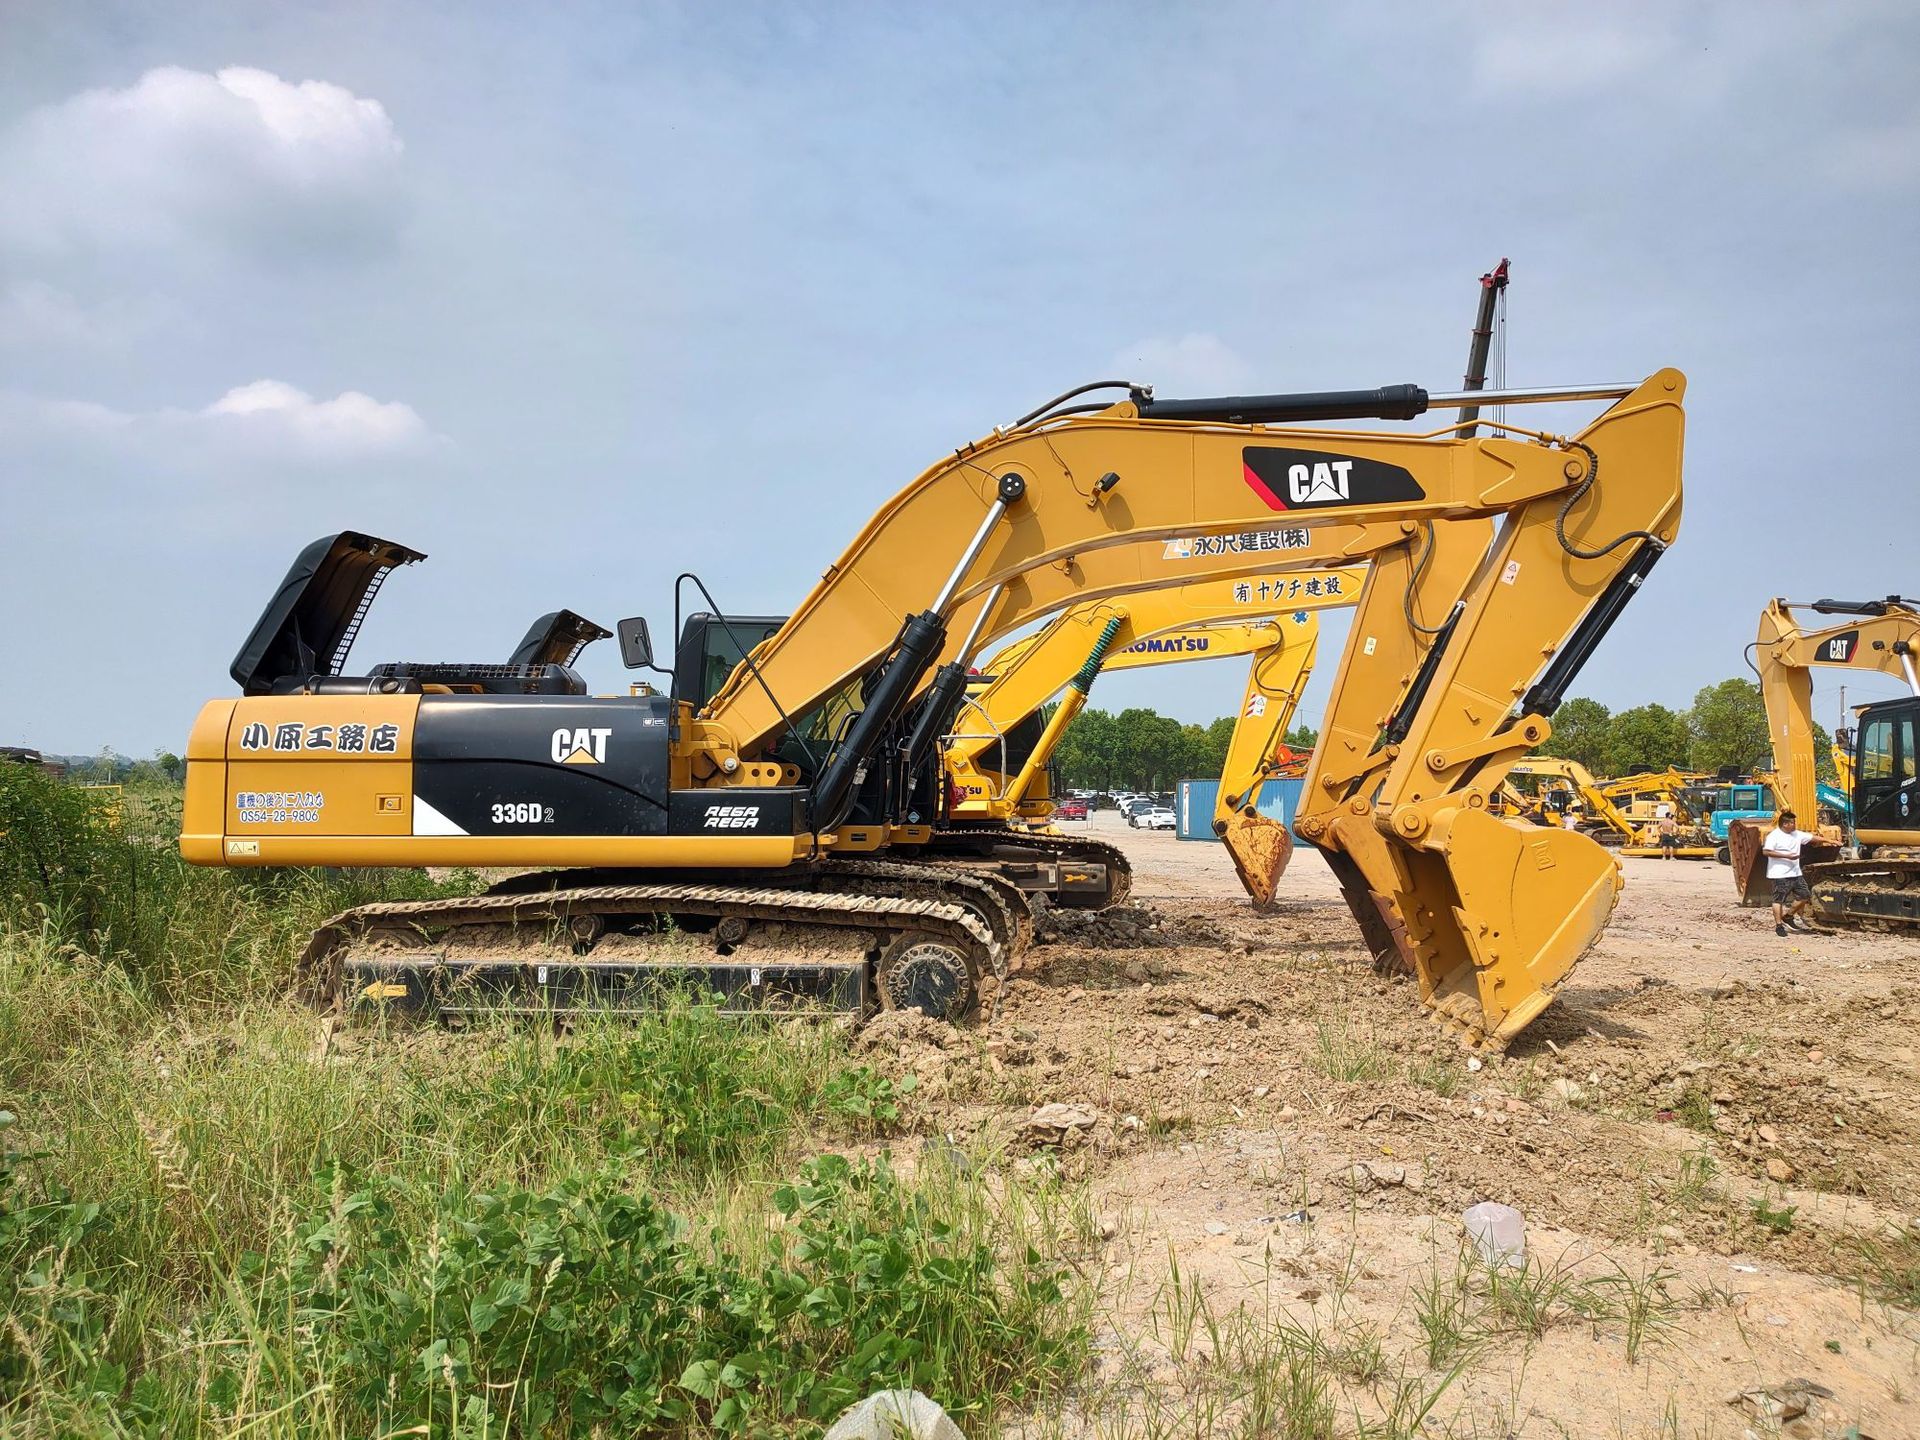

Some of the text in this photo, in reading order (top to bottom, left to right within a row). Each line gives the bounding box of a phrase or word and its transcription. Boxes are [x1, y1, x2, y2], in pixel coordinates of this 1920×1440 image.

[1288, 461, 1352, 502] CAT
[1830, 640, 1847, 659] CAT
[241, 722, 399, 752] 小原工務店
[551, 728, 612, 763] CAT
